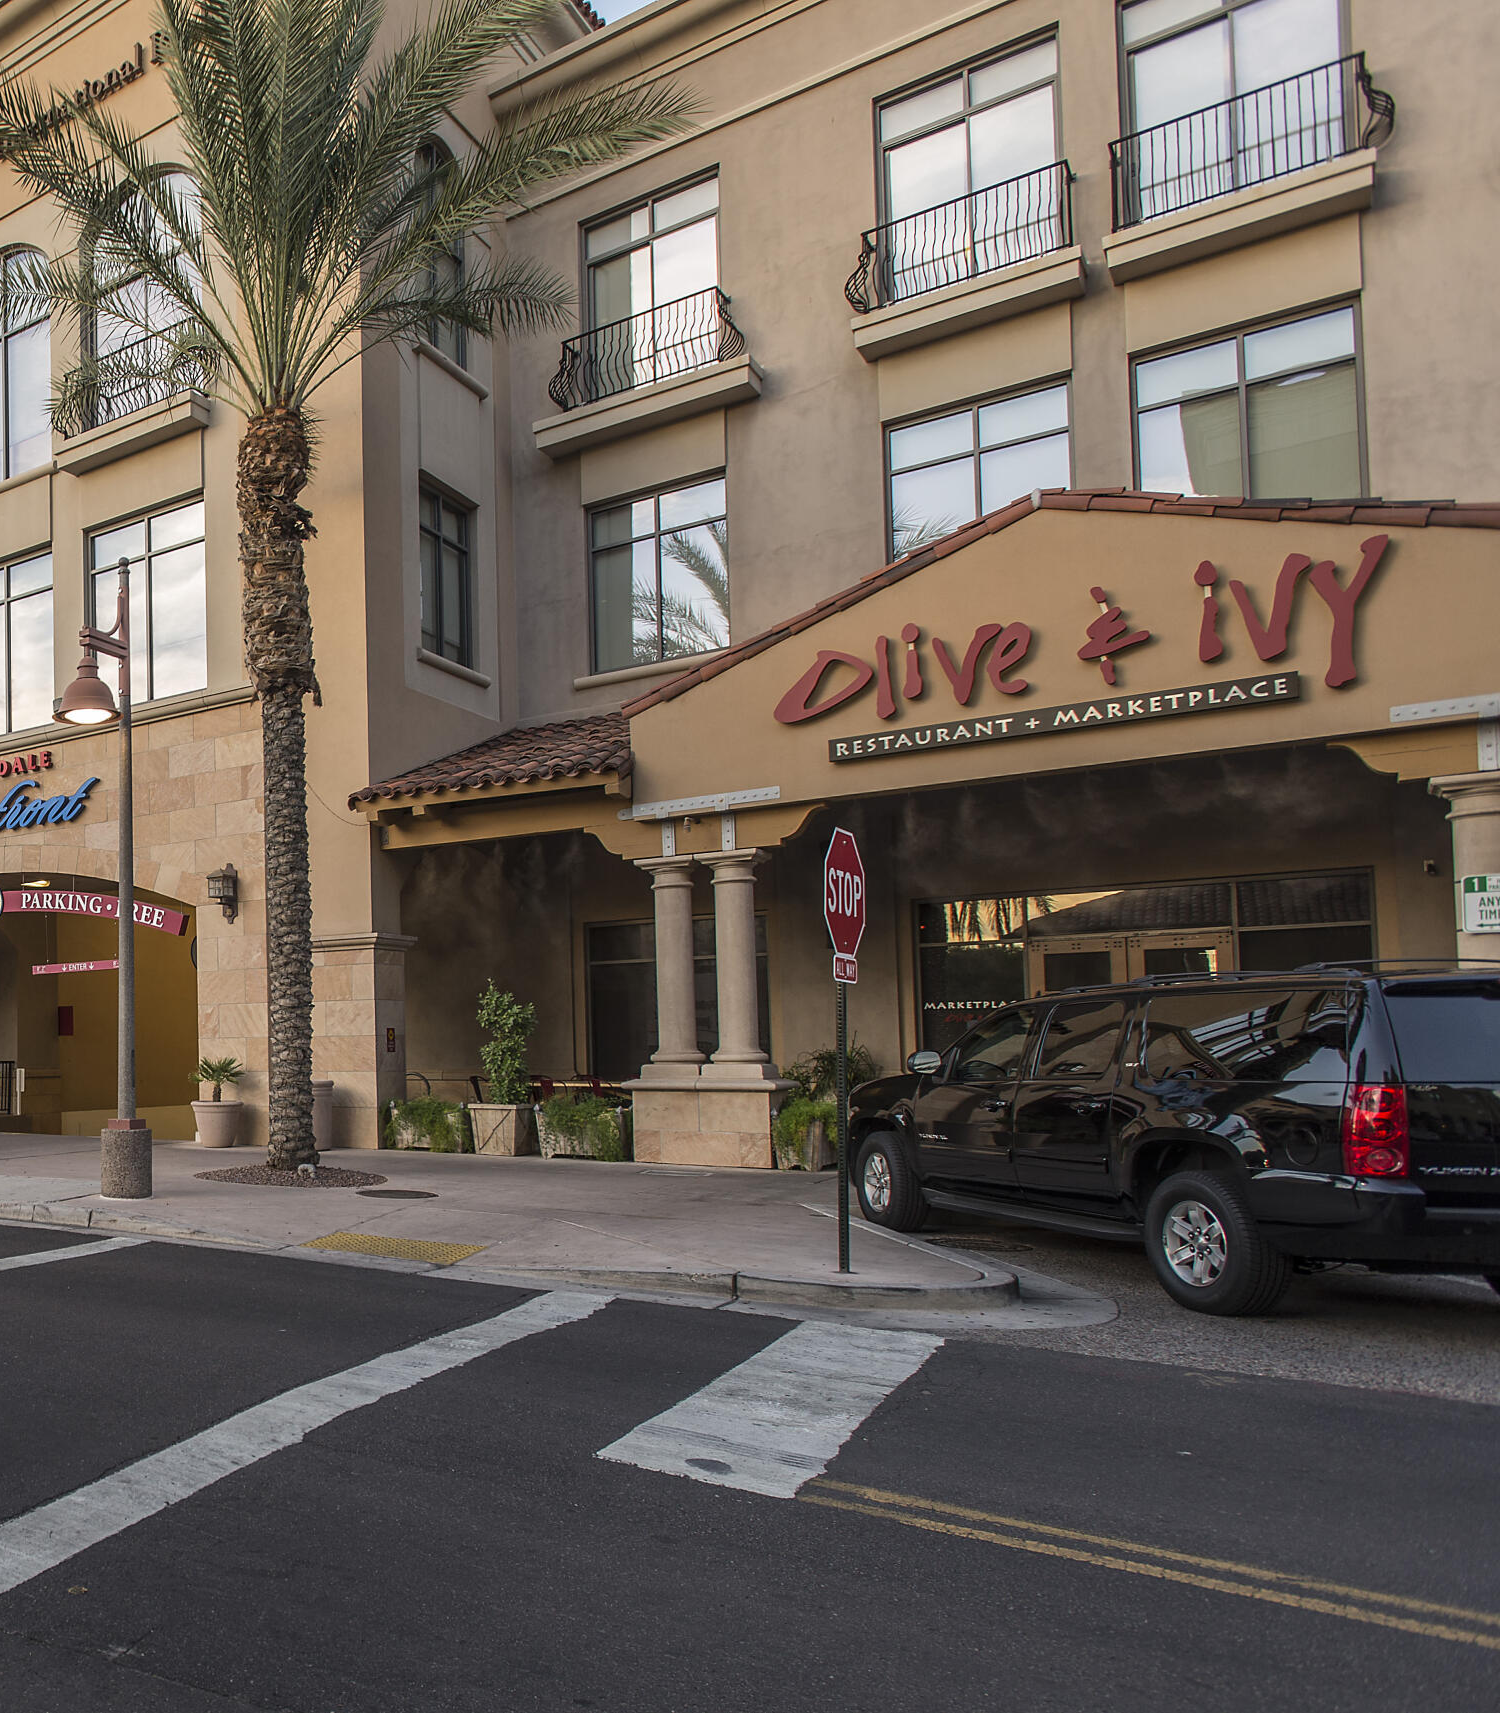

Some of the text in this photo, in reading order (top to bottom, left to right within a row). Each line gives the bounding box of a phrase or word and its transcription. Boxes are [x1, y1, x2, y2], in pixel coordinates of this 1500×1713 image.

[835, 718, 1014, 757] RESTAURANT
[1052, 677, 1289, 727] MARKETPLACE
[828, 867, 862, 918] STOP
[1472, 878, 1479, 892] 1
[20, 892, 103, 914] PARKING
[68, 962, 88, 972] ENTER
[836, 961, 856, 979] ALL WAY
[924, 1000, 1017, 1010] MARKETPLA
[1418, 1166, 1488, 1176] YUKON
